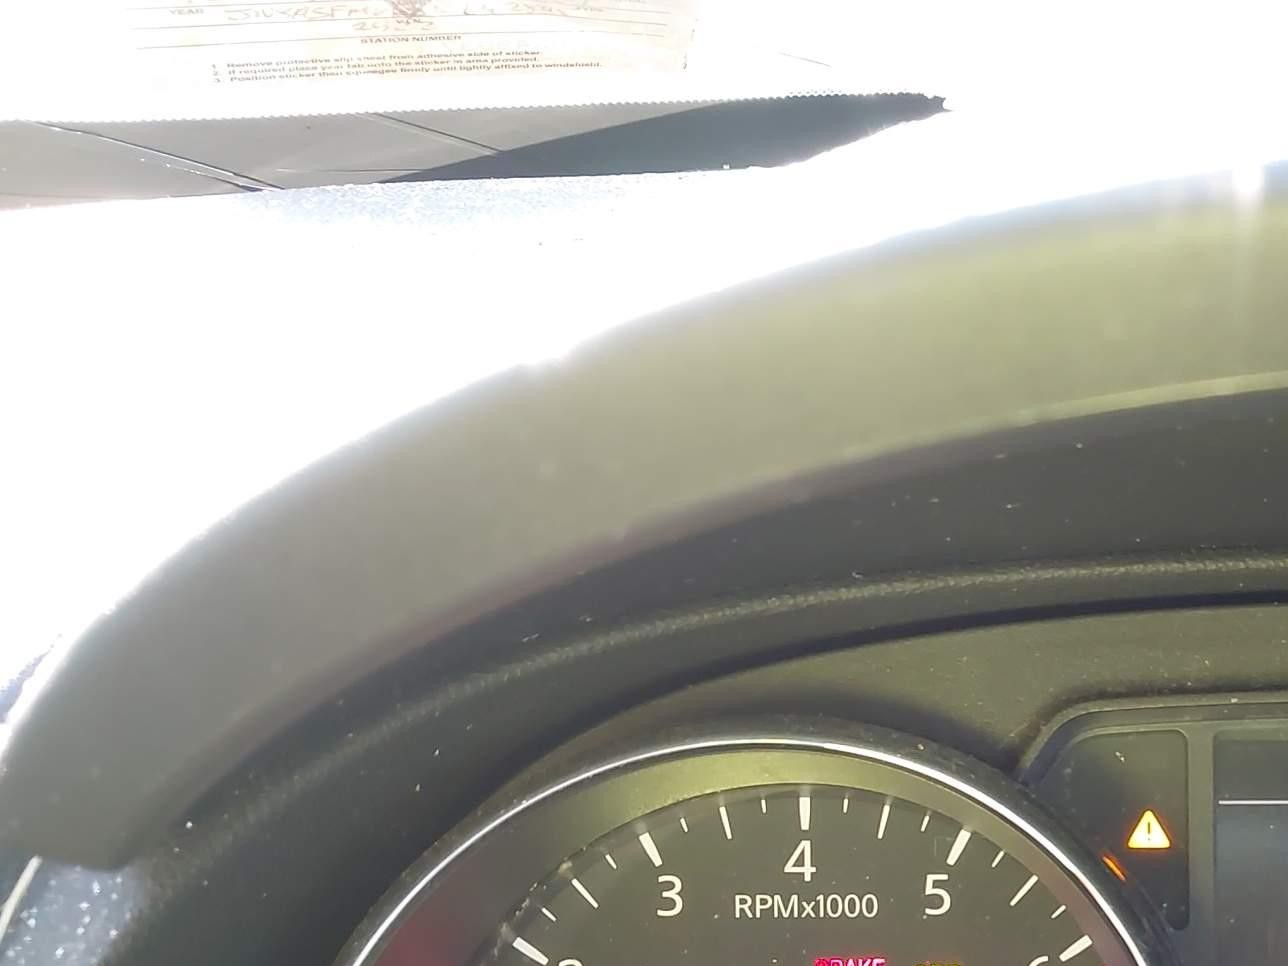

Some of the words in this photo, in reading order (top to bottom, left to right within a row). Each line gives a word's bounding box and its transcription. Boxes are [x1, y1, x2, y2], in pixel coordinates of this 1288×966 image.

[360, 36, 409, 44] STATION
[411, 34, 461, 42] NUMBER
[783, 840, 817, 882] 4
[656, 875, 683, 917] 3
[735, 893, 879, 918] RPMx1000
[925, 873, 951, 915] 5
